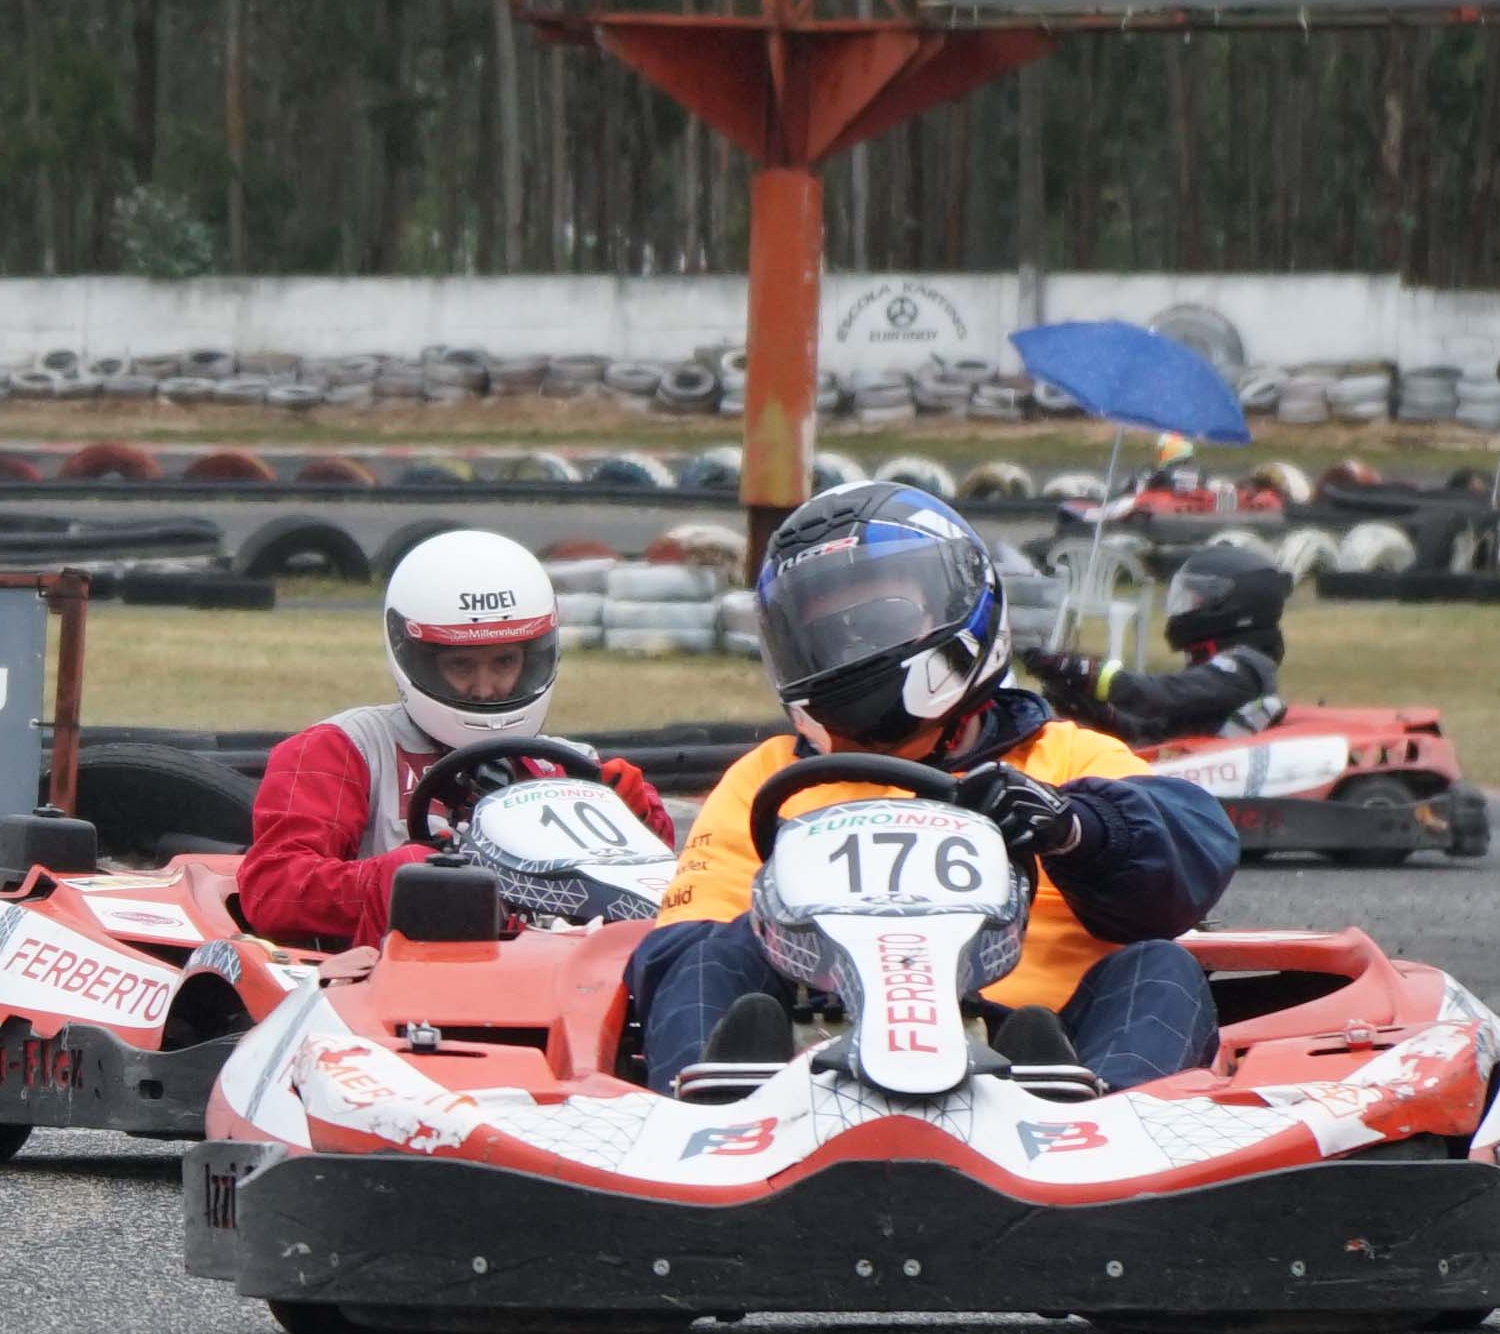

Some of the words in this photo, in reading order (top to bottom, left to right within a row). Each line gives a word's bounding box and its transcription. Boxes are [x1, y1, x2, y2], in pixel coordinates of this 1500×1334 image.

[458, 590, 517, 612] SHOEI
[502, 786, 607, 809] EUROINDY
[539, 800, 629, 850] 10
[806, 813, 970, 837] EUROINDY
[828, 831, 983, 894] 176
[3, 938, 171, 1022] FERBERTO
[876, 933, 938, 1054] FERBERTO
